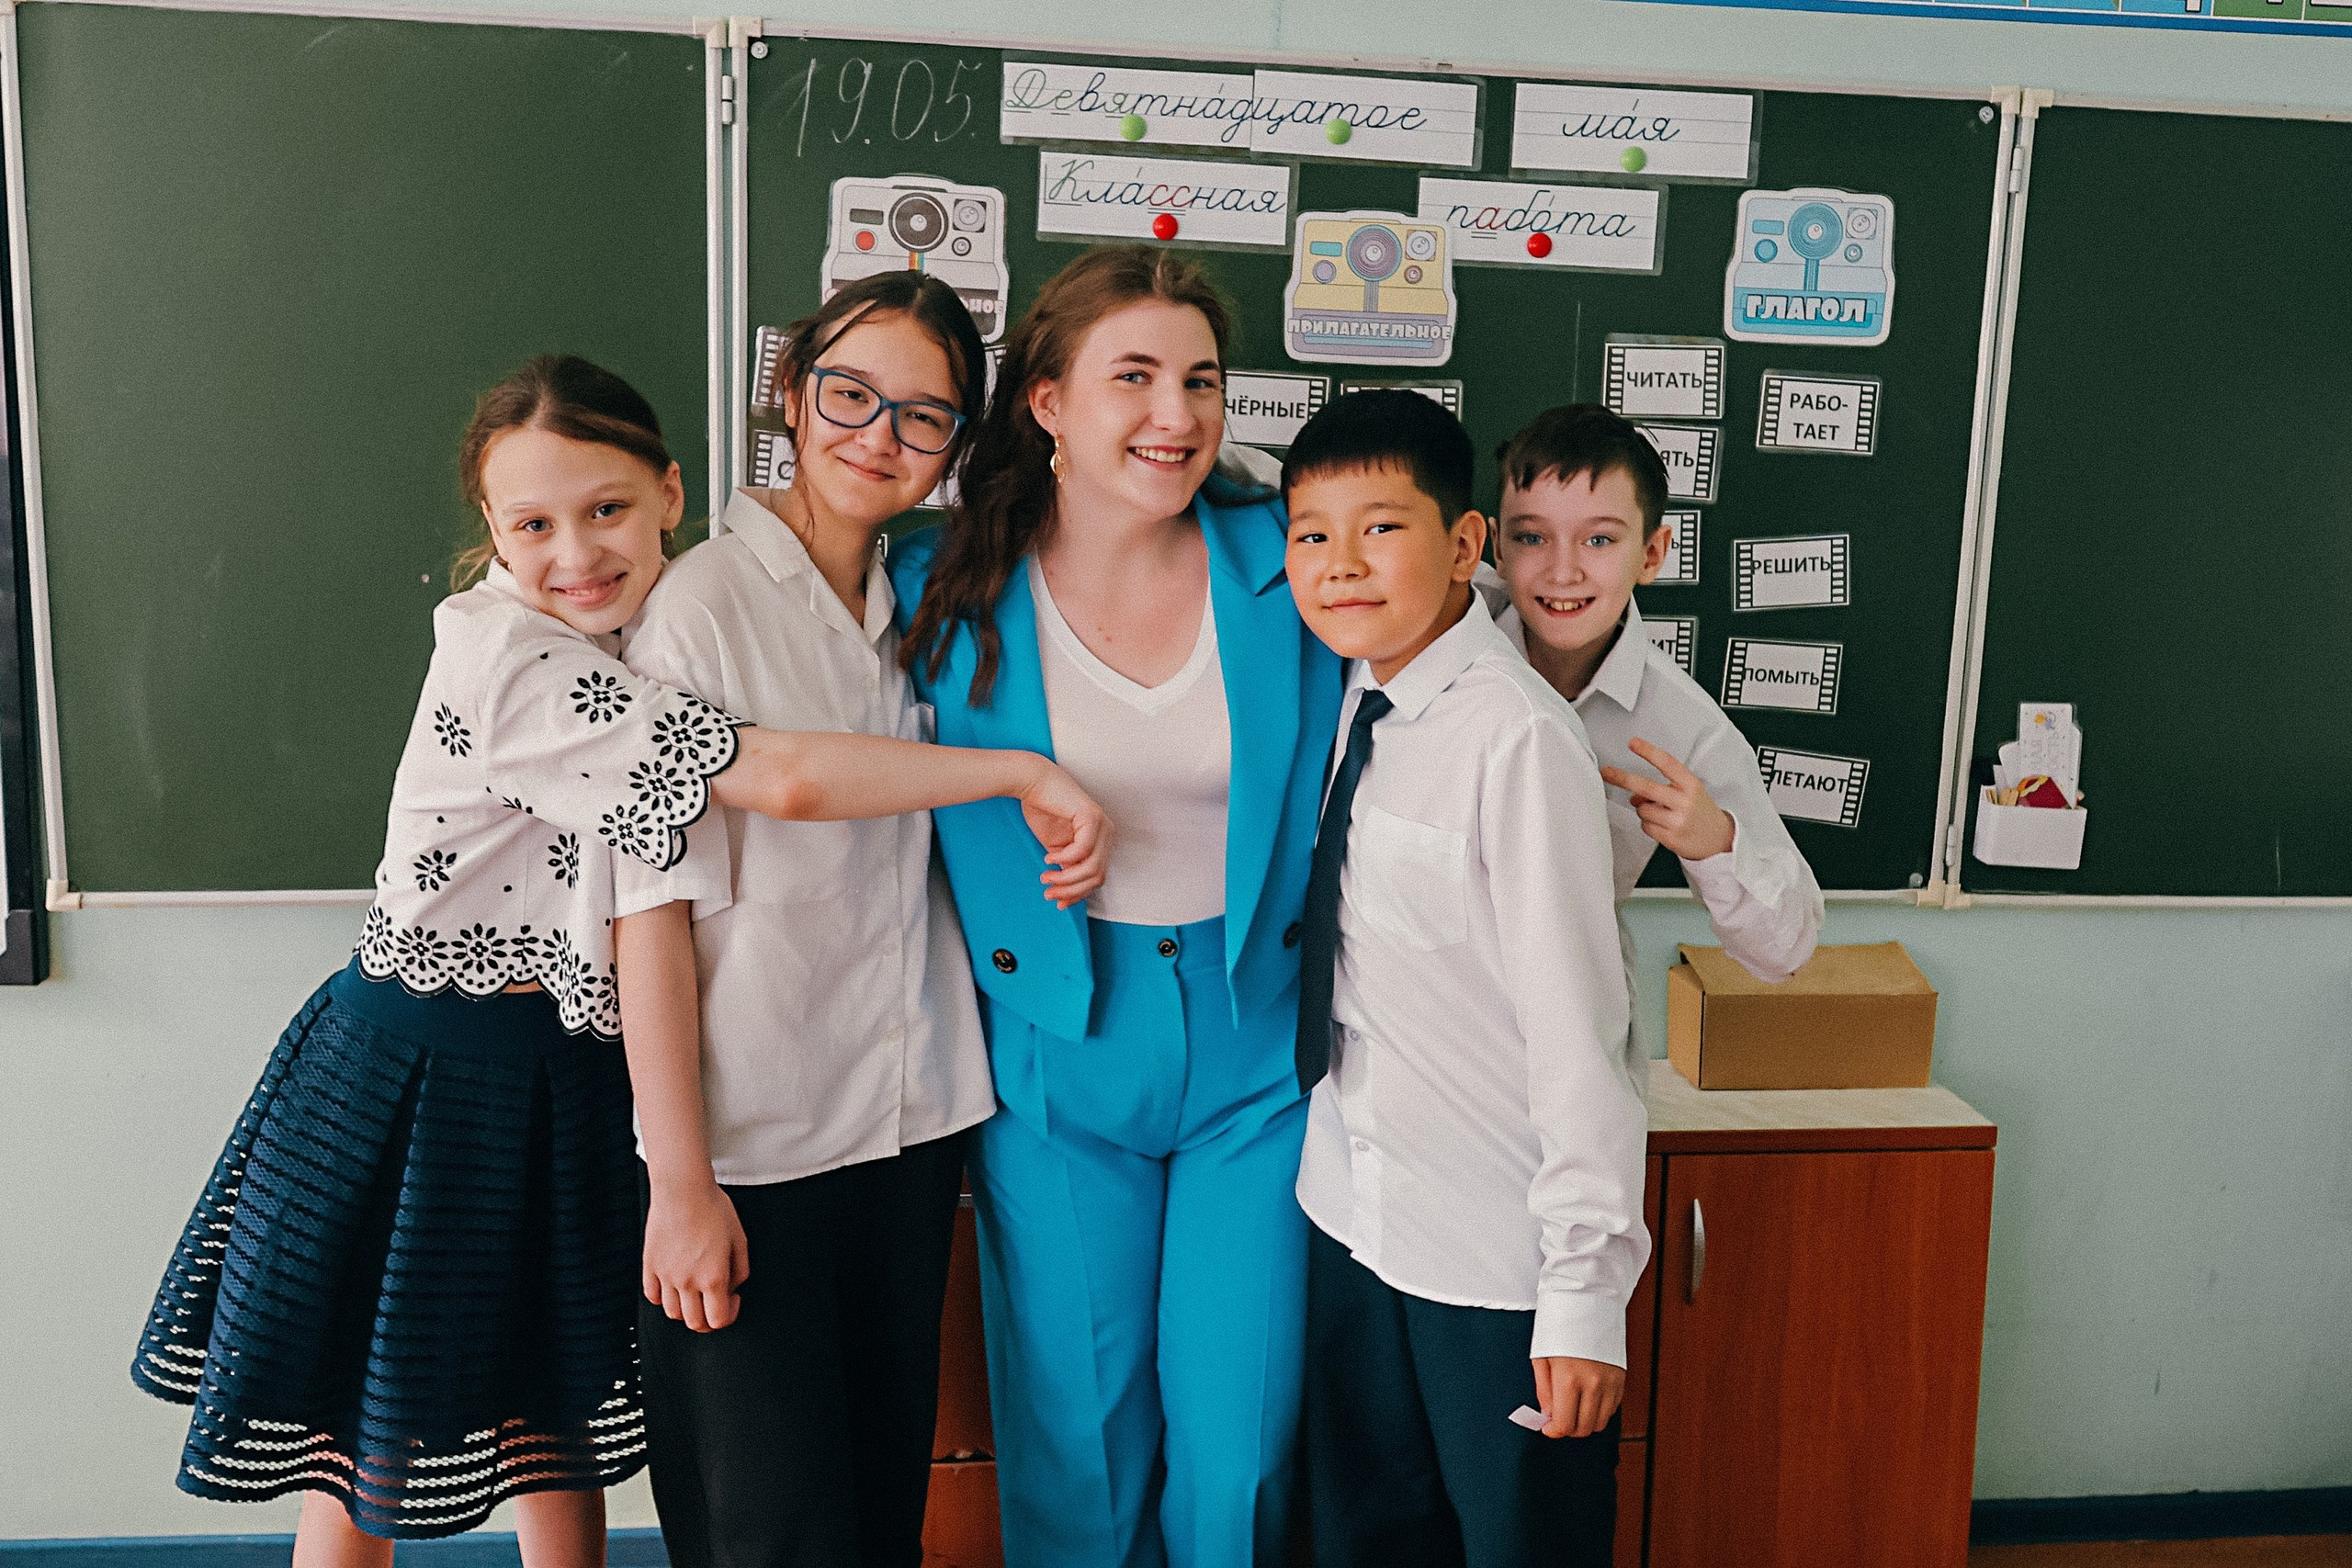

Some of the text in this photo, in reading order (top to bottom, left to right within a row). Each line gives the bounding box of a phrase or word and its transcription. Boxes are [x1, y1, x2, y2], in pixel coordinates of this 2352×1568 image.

[1746, 294, 1867, 322] ГЛАГОЛ
[1287, 318, 1453, 340] ПРИЛАГАТЕЛЬНОЕ
[1627, 372, 1702, 388] ЧИТАТЬ
[1225, 395, 1306, 419] ЧЁРНЫЕ
[1790, 393, 1849, 412] РАБО-
[1793, 423, 1840, 440] ТАЕТ
[1751, 557, 1831, 574] РЕШИТЬ
[1743, 668, 1820, 685] ПОМЫТЬ
[1771, 770, 1848, 793] ЛЕТАЮТ
